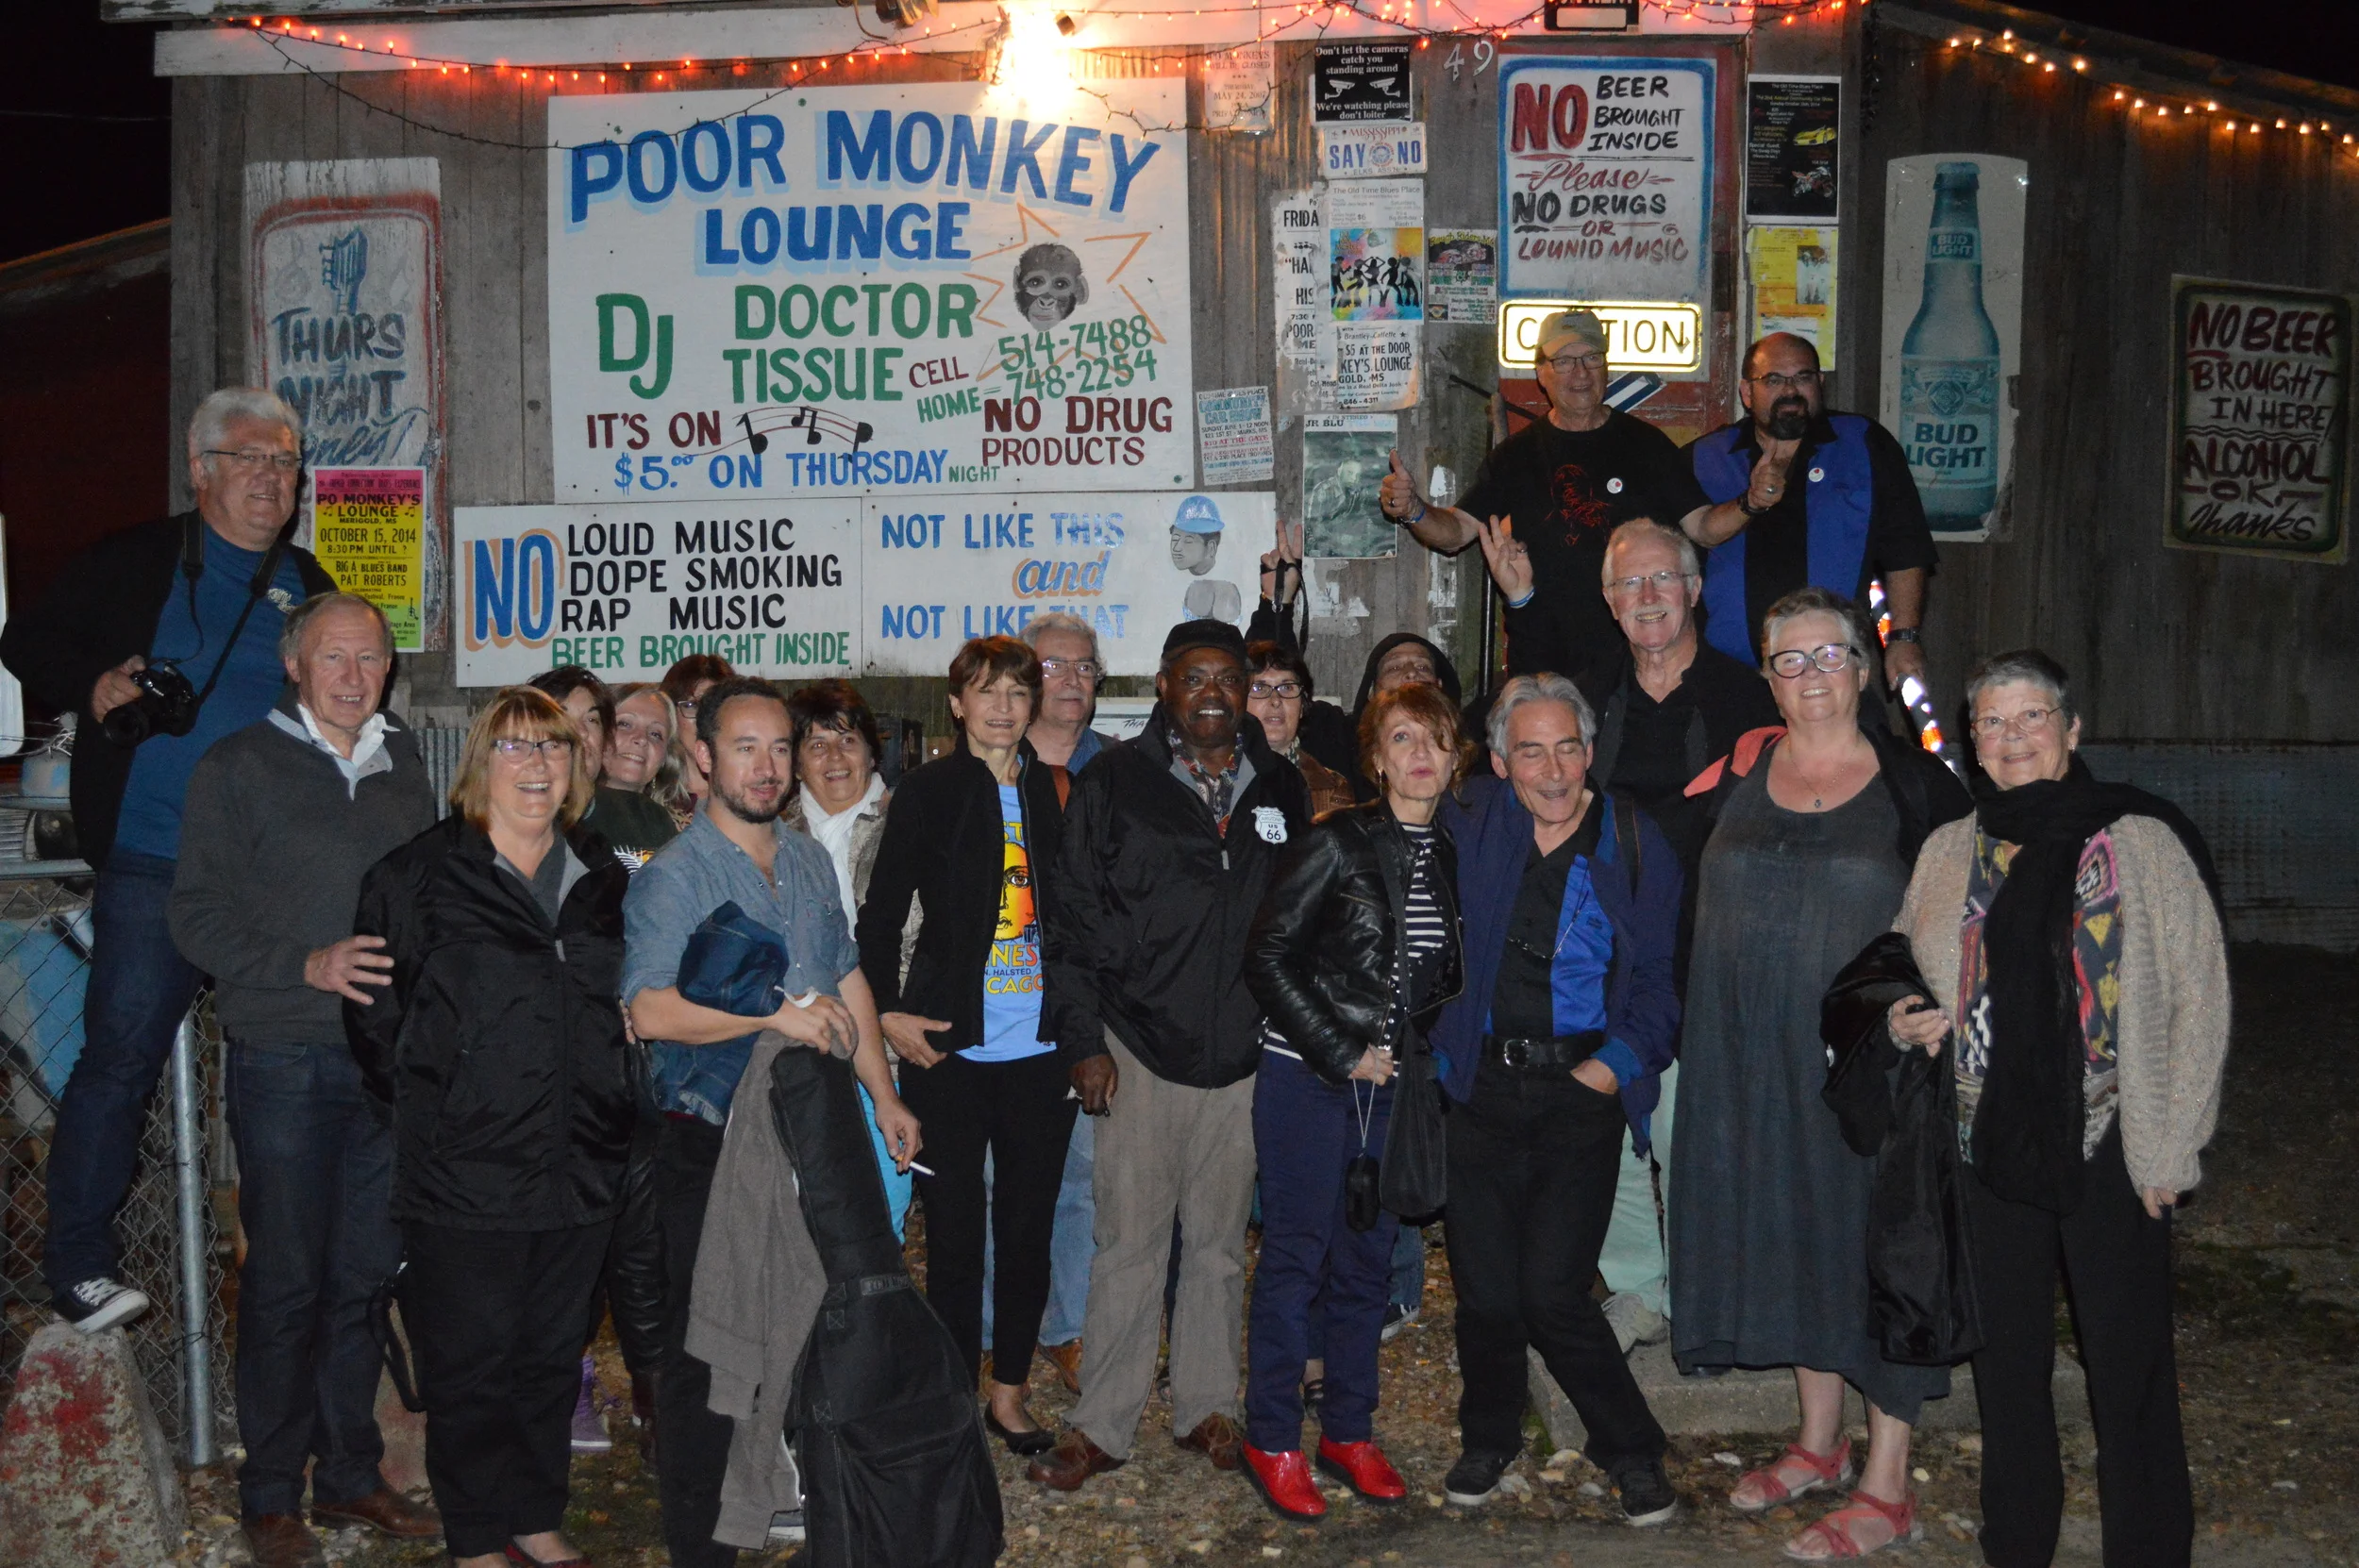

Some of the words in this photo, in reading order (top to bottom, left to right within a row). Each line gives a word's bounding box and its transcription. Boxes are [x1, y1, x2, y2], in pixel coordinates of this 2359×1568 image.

[1315, 45, 1340, 57] Don't
[1342, 45, 1354, 55] let
[1355, 44, 1370, 54] the
[1371, 45, 1409, 54] cameras
[1340, 56, 1365, 65] catch
[1365, 57, 1383, 65] you
[1326, 65, 1364, 75] standing
[1365, 63, 1398, 74] around
[1213, 92, 1232, 101] MAY
[1316, 102, 1342, 111] We're
[1344, 101, 1381, 111] watching
[1383, 100, 1410, 110] please
[1339, 110, 1362, 120] don't
[1363, 110, 1386, 120] loiter
[1510, 82, 1589, 154] NO
[1596, 75, 1669, 100] BEER
[1594, 105, 1685, 129] BROUGHT
[1329, 142, 1366, 170] SAY
[1397, 140, 1422, 165] NO
[1587, 130, 1680, 152] INSIDE
[569, 113, 787, 225] POOR
[825, 108, 1162, 215] MONKEY
[1528, 160, 1650, 192] Please
[1380, 186, 1399, 194] Blues
[1400, 185, 1420, 193] Place
[1282, 209, 1319, 227] FRIDA
[1512, 190, 1562, 225] NO
[1569, 192, 1667, 219] DRUGS
[703, 201, 972, 268] LOUNGE
[1581, 219, 1616, 237] OR
[1936, 234, 1968, 245] BUD
[1608, 236, 1690, 263] MUSIC
[1932, 243, 1973, 257] LIGHT
[734, 282, 977, 341] DOCTOR
[271, 307, 407, 366] THURS
[1514, 316, 1687, 355] CTION
[2187, 301, 2241, 349] NO
[2240, 306, 2340, 358] BEER
[595, 292, 674, 400] DJ
[909, 356, 970, 389] CELL
[997, 314, 1151, 373] 514-7488
[1359, 346, 1369, 356] AT
[1371, 345, 1386, 355] THE
[1388, 342, 1411, 354] DOOR
[723, 346, 904, 404] TISSUE
[1338, 374, 1366, 384] GOLD,
[1371, 373, 1385, 382] MS
[1340, 358, 1371, 375] KEY'S
[1374, 356, 1412, 372] LOUNGE
[916, 387, 982, 424] HOME
[1006, 348, 1157, 406] 748-2254
[2189, 359, 2337, 401] BROUGHT
[277, 370, 408, 426] NIGHT
[2210, 395, 2253, 421] IN
[984, 395, 1042, 434] NO
[1064, 395, 1174, 435] DRUG
[586, 411, 651, 450] IT'S
[668, 409, 722, 448] ON
[1914, 421, 1979, 447] BUD
[980, 435, 1146, 468] PRODUCTS
[1905, 442, 1987, 469] LIGHT
[2183, 436, 2333, 485] ALCOHOL
[708, 452, 763, 490] ON
[785, 448, 949, 489] THURSDAY
[947, 464, 1001, 484] NIGHT
[316, 493, 338, 506] PO
[343, 493, 421, 506] MONKEY'S
[338, 505, 399, 518] LOUNGE
[881, 513, 945, 549] NOT
[963, 512, 1035, 549] LIKE
[1049, 511, 1126, 549] THIS
[2187, 498, 2317, 542] Thanks
[320, 527, 368, 543] OCTOBER
[374, 527, 388, 544] 15,
[392, 527, 417, 543] 2014
[327, 544, 348, 554] 8:30
[349, 544, 364, 555] PM
[368, 544, 397, 555] UNTIL
[568, 522, 655, 558] LOUD
[675, 517, 795, 555] MUSIC
[335, 560, 349, 573] BIG
[350, 560, 358, 573] A
[360, 563, 385, 573] BLUES
[387, 563, 408, 573] BAND
[341, 574, 359, 586] PAT
[363, 574, 407, 587] ROBERTS
[570, 559, 668, 596] DOPE
[684, 553, 843, 593] SMOKING
[1014, 549, 1113, 597] and
[471, 531, 557, 645] NO
[560, 597, 631, 634] RAP
[669, 592, 787, 631] MUSIC
[881, 604, 946, 640] NOT
[551, 635, 626, 670] BEER
[639, 632, 767, 668] BROUGHT
[775, 631, 850, 666] INSIDE
[1266, 829, 1281, 841] 66
[985, 943, 1039, 969] NES
[986, 974, 1045, 995] CAGO
[993, 967, 1032, 977] HALSTED
